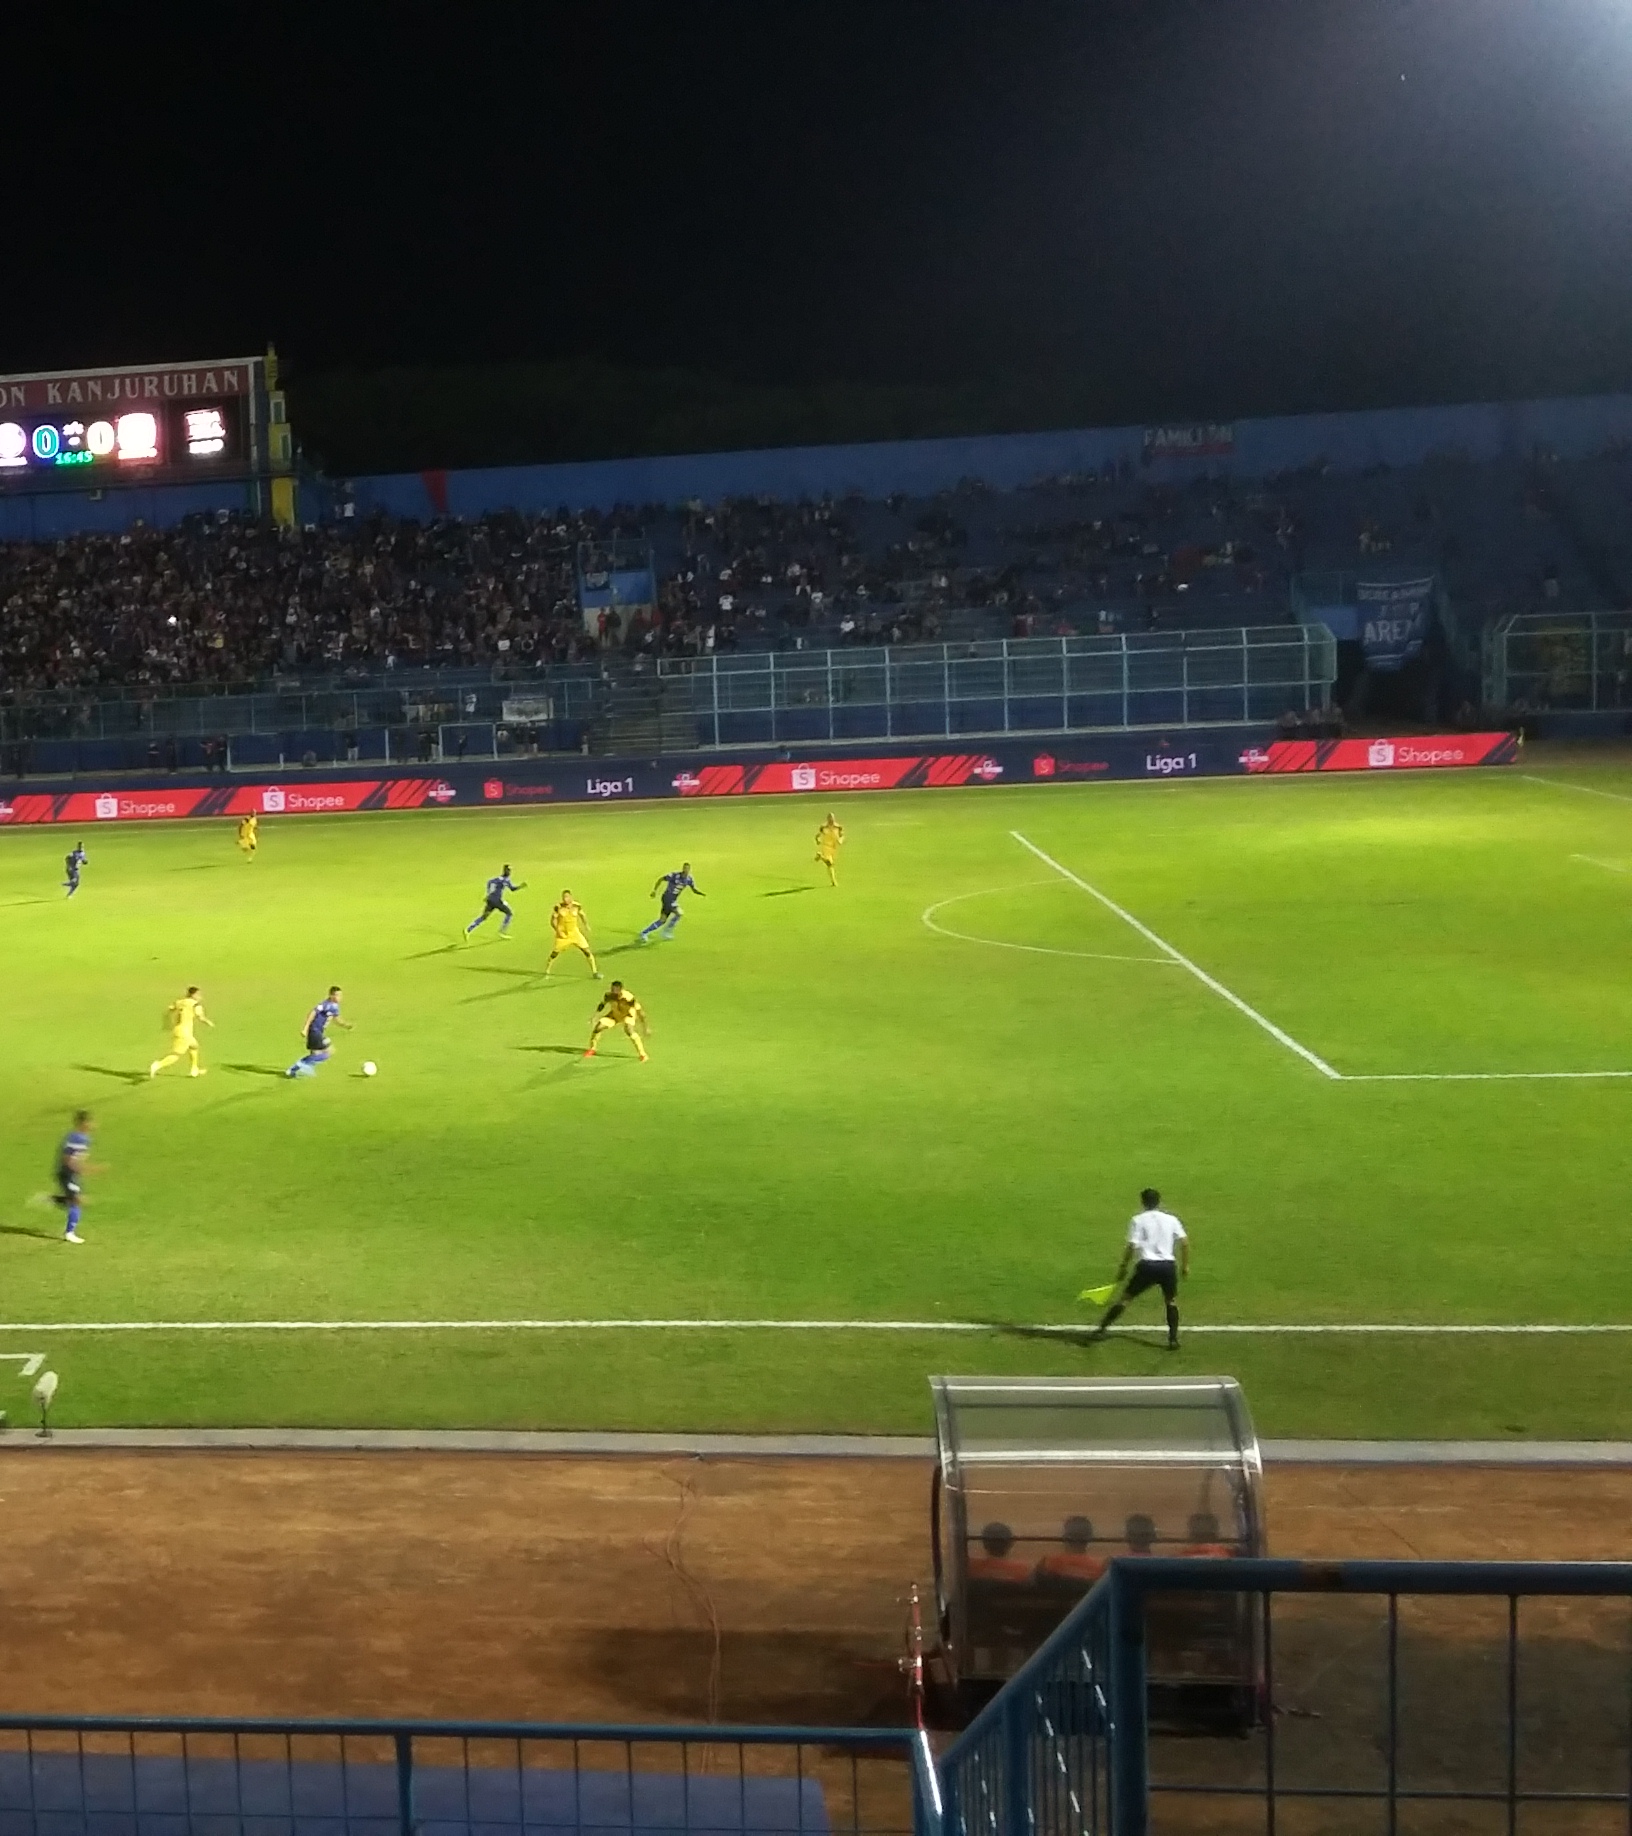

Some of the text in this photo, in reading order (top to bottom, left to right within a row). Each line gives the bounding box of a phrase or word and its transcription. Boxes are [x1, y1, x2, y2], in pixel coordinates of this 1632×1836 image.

[46, 370, 240, 405] KANJURUHAN
[32, 424, 60, 459] 0
[1146, 753, 1197, 774] Liga 1
[1398, 745, 1464, 764] Shopee
[586, 776, 634, 798] Liga 1
[819, 770, 881, 789] Shopee
[120, 799, 176, 817] Shopee
[288, 792, 345, 811] Shopee
